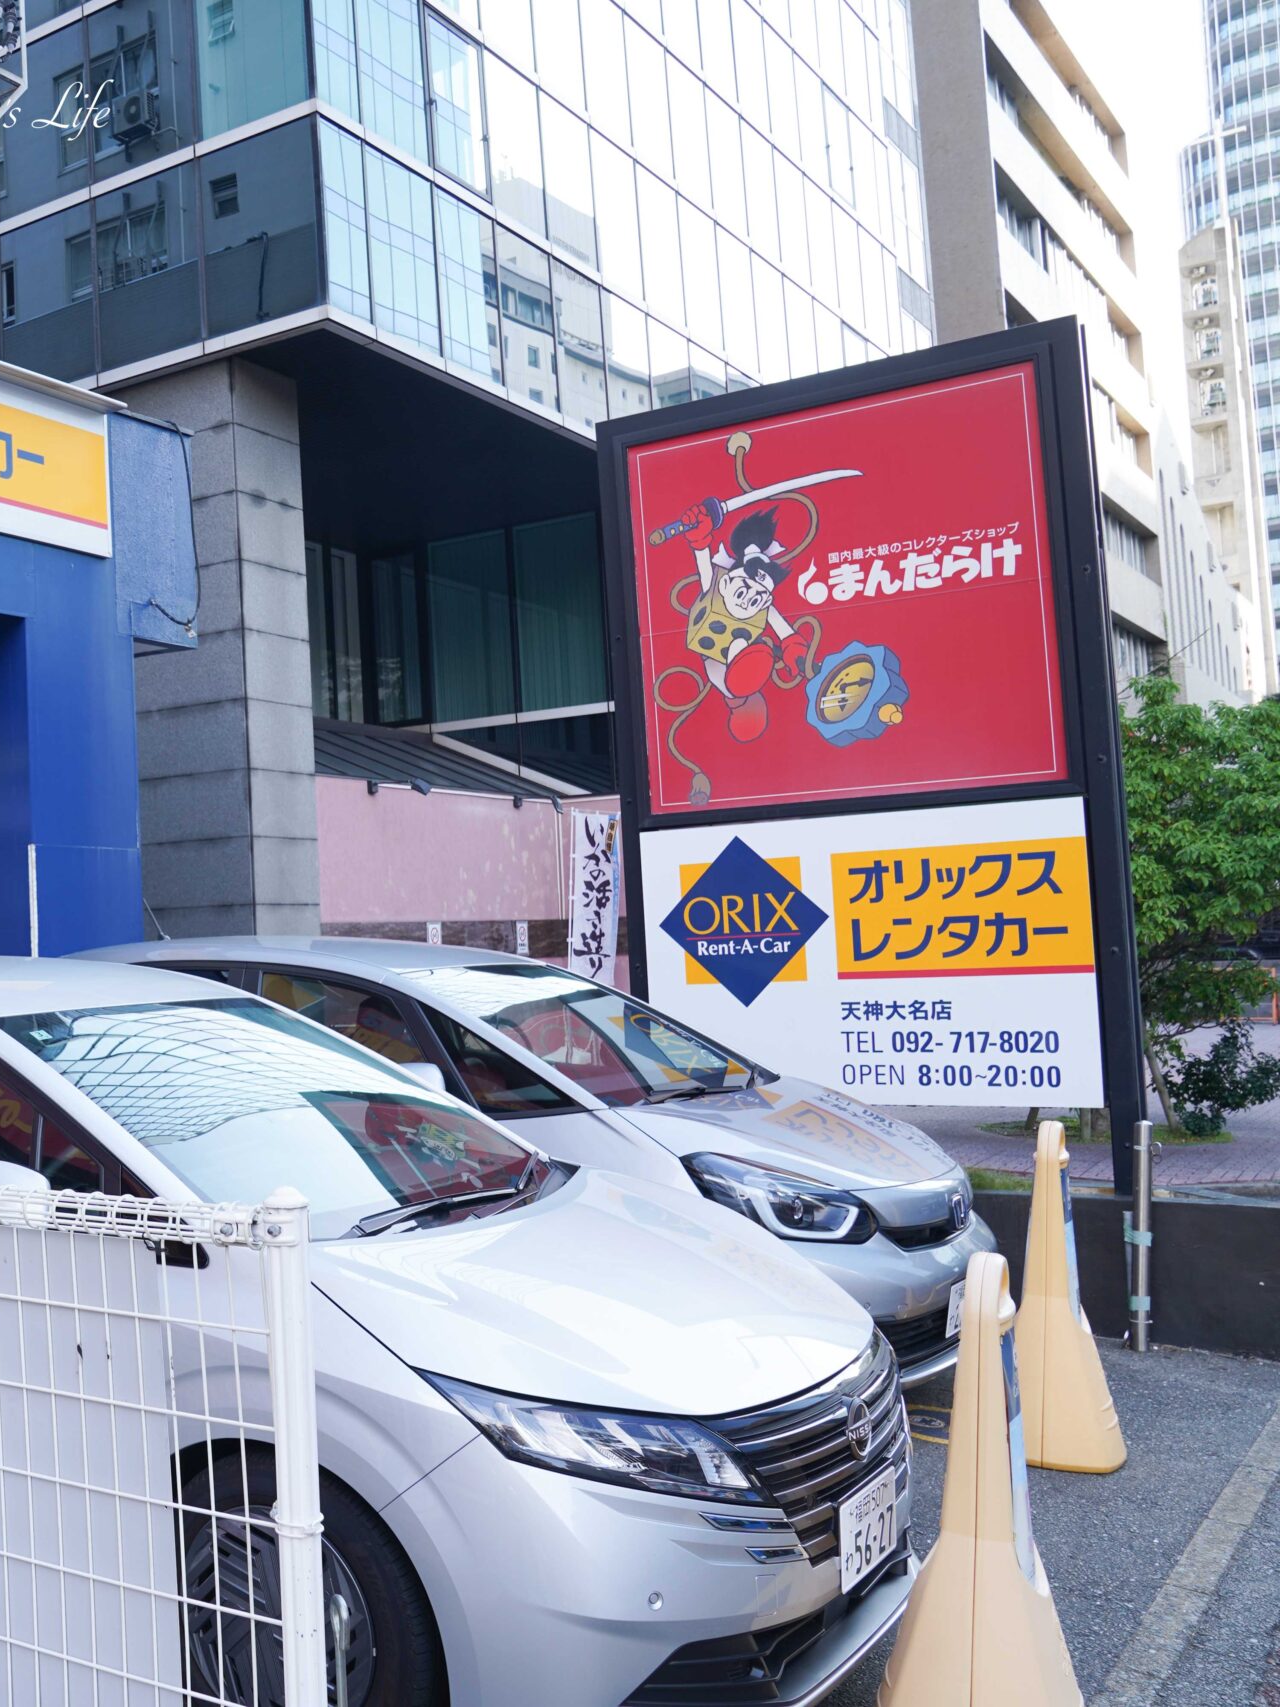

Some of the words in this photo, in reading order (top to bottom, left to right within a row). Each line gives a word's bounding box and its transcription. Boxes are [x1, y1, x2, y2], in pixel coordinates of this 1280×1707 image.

[828, 521, 1019, 564] 国内最大級のコレクターズショップ
[828, 538, 1022, 601] まんだらけ
[847, 850, 1063, 904] オリックス
[683, 891, 800, 936] ORIX
[697, 937, 791, 957] Rent-A-Car
[851, 912, 1069, 961] レンタカー
[840, 1000, 952, 1021] 天神大名店
[841, 1031, 883, 1055] TEL
[842, 1064, 905, 1086] OPEN
